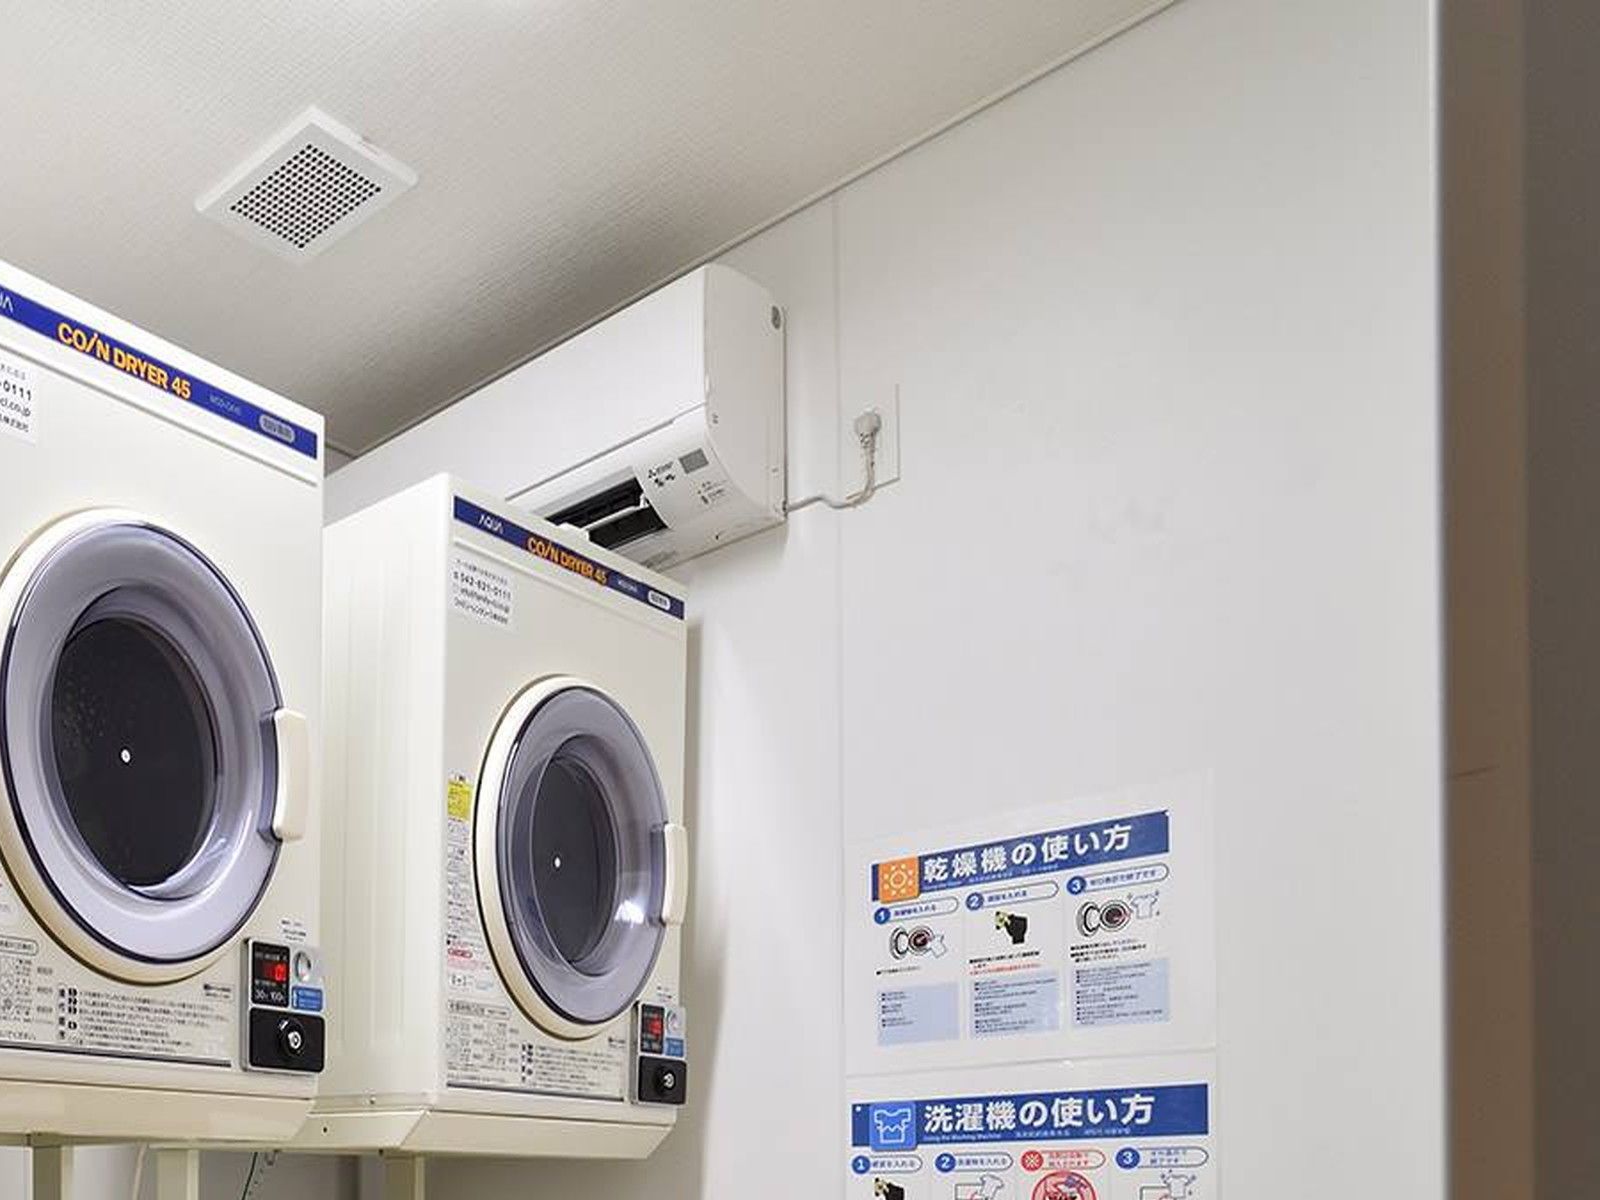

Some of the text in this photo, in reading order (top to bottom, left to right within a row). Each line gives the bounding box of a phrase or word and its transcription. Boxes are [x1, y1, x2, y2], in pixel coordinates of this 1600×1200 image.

[114, 350, 168, 394] DRYER
[171, 377, 190, 399] 45
[924, 824, 1131, 884] 乾燥機の使い方
[925, 1094, 1155, 1133] 洗濯機の使い方
